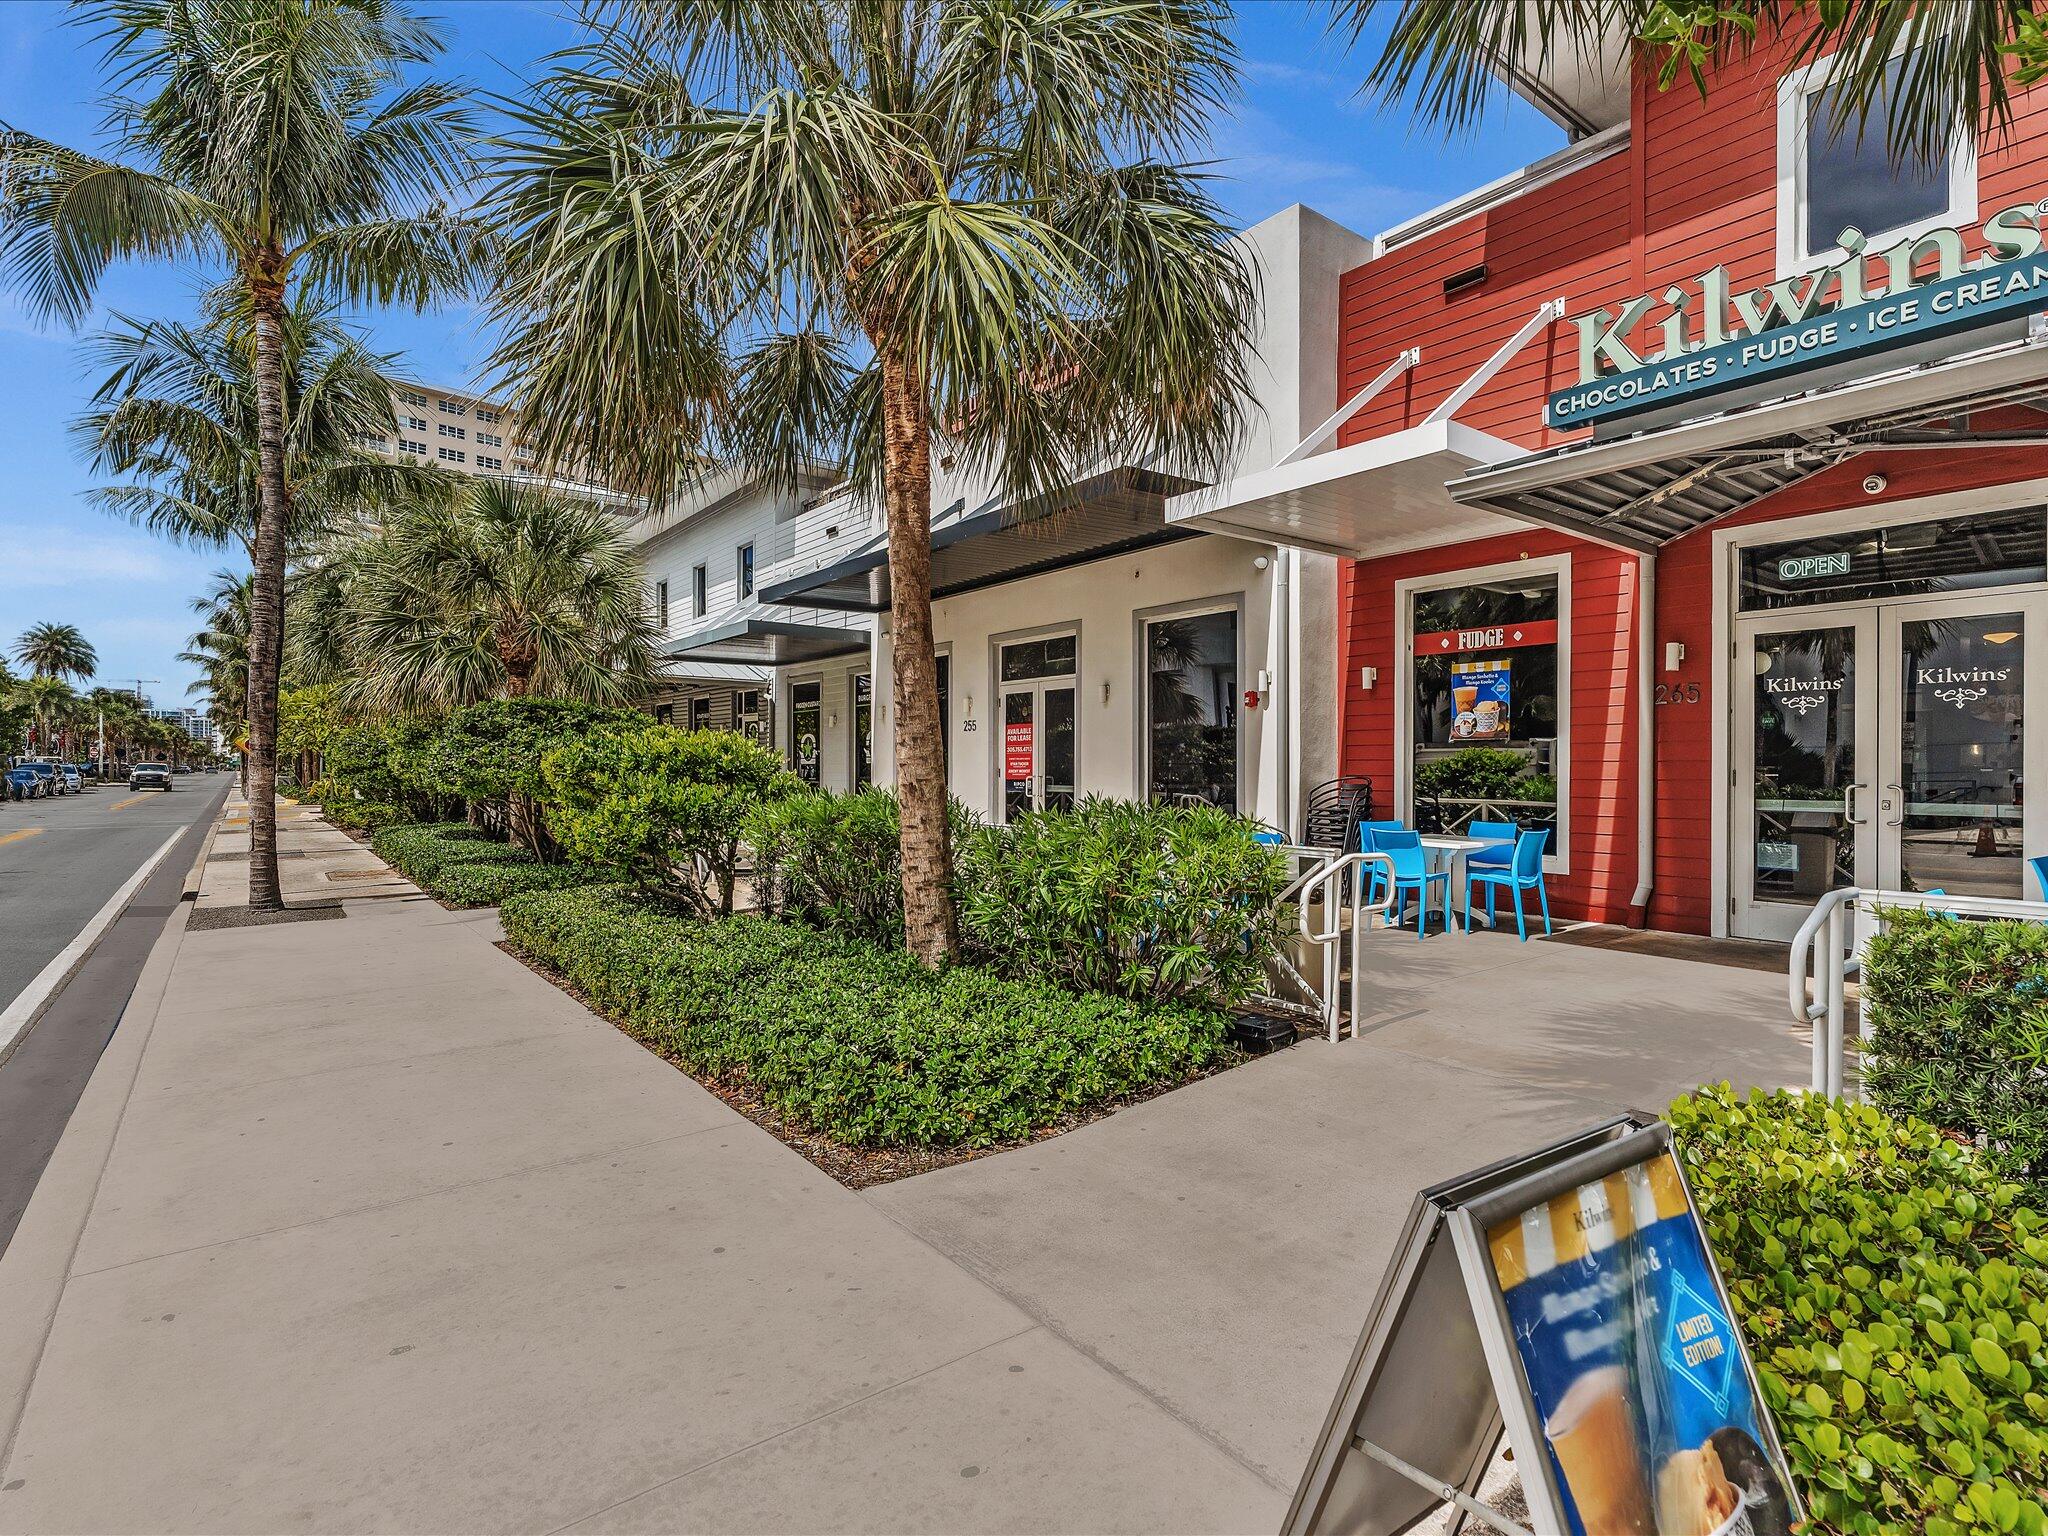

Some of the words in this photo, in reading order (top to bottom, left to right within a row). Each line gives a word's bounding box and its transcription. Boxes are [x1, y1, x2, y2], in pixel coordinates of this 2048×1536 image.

[1568, 202, 2041, 388] Kilwins
[1555, 357, 1717, 416] CHOCOLATES
[1742, 322, 1838, 366] FUDGE
[1868, 300, 1919, 331] ICE
[1781, 555, 1847, 578] OPEN
[1458, 629, 1504, 650] FUDGE
[1766, 676, 1842, 693] Kilwins
[1917, 667, 2008, 685] Kilwins
[1655, 683, 1700, 704] 265
[963, 719, 977, 732] 255
[1675, 1313, 1714, 1343] LIMITED
[1682, 1335, 1725, 1368] EDITION!
